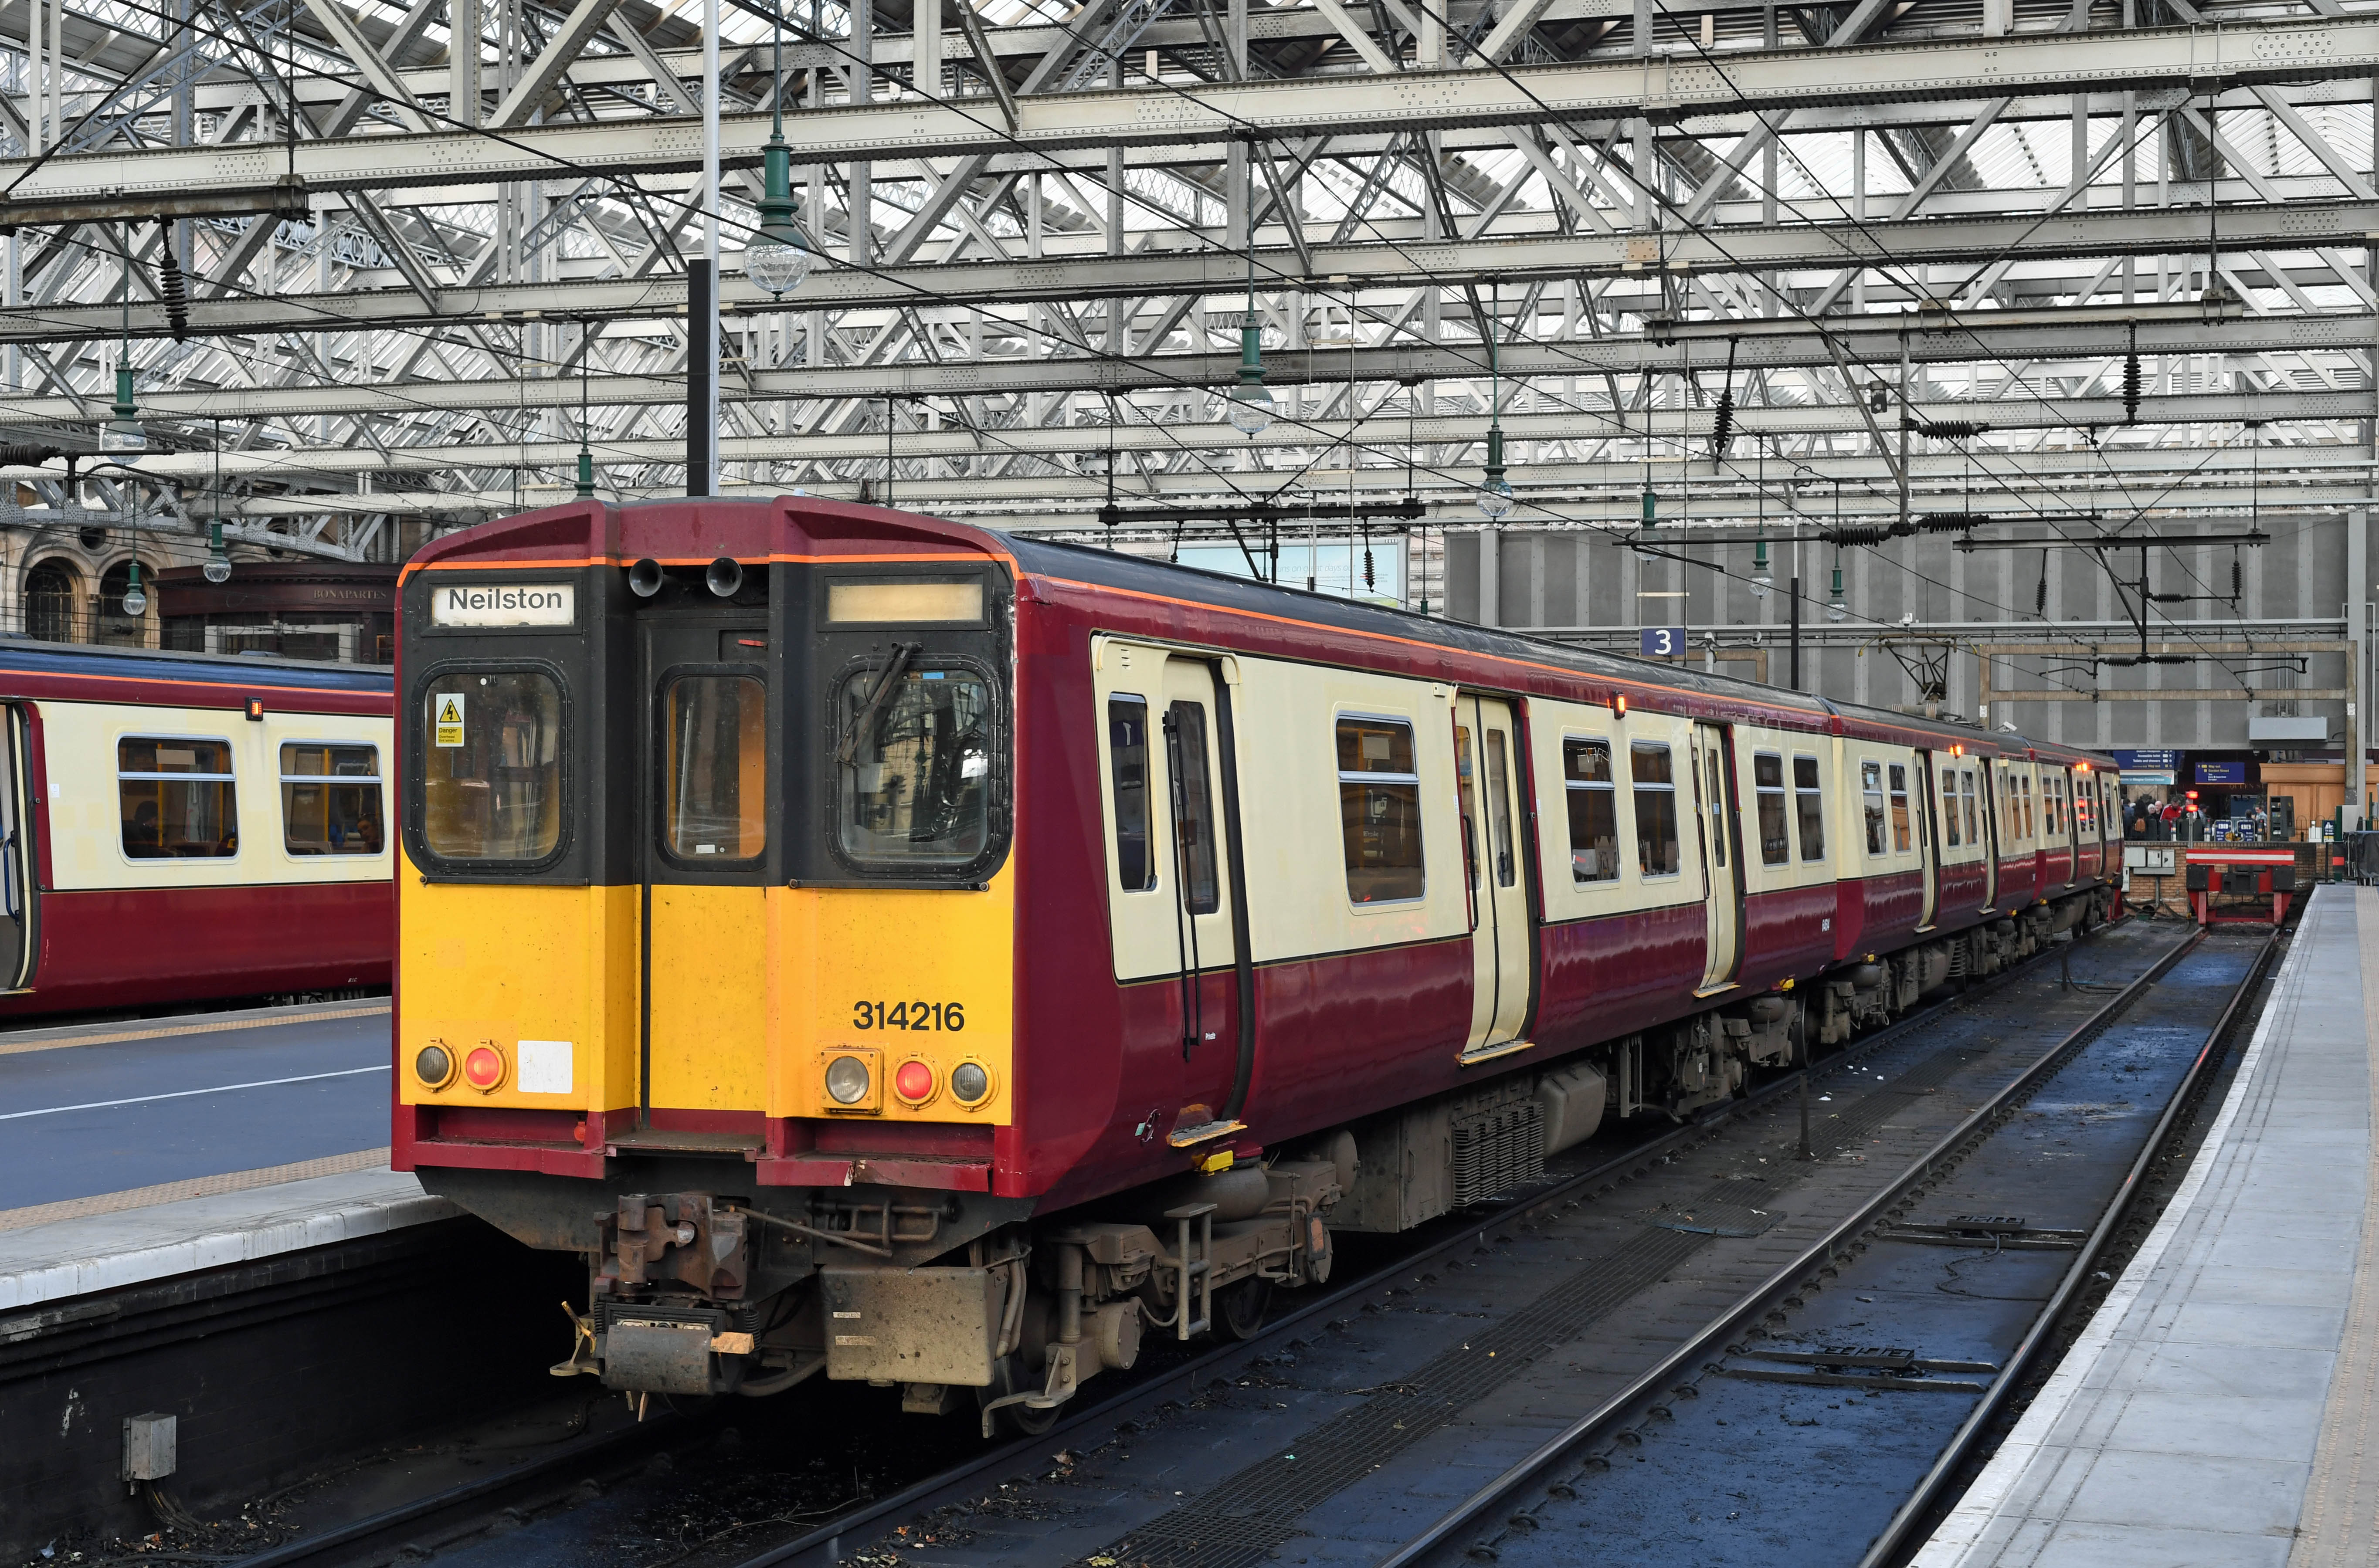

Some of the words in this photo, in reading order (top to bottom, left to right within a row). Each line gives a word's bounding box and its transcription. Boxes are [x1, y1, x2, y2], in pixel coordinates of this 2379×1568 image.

[1325, 564, 1341, 573] days
[314, 590, 387, 599] BONAPARTES
[449, 588, 561, 610] Neilston
[1655, 630, 1672, 655] 3
[853, 1000, 964, 1031] 314216
[1205, 1032, 1216, 1040] Private
